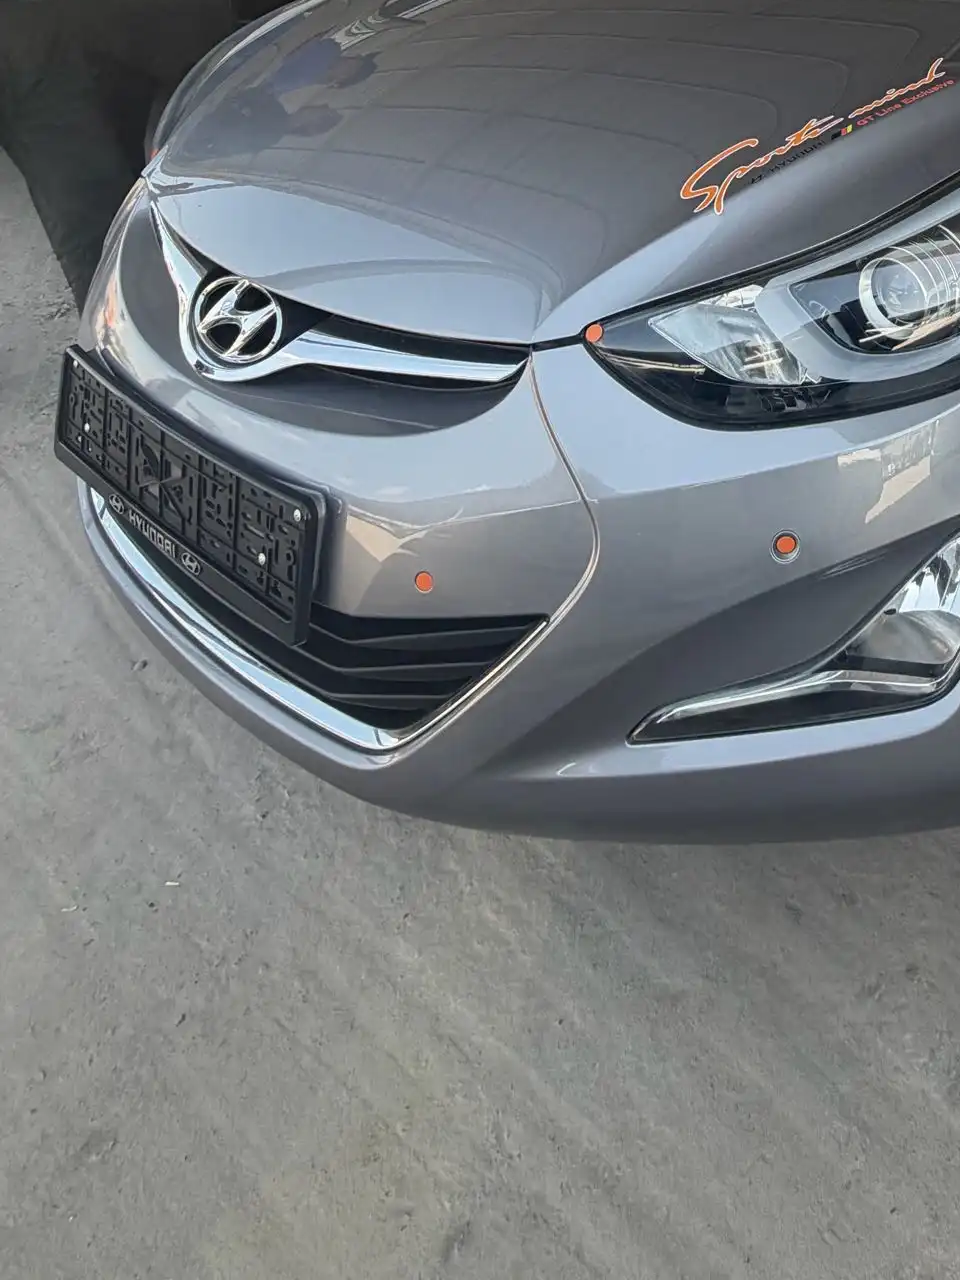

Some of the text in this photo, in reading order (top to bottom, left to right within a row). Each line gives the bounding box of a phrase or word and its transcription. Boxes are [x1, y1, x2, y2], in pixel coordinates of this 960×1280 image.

[856, 114, 875, 126] GT
[875, 103, 902, 117] Line
[901, 79, 955, 105] Exclusive
[128, 508, 176, 558] HYUNDAI
